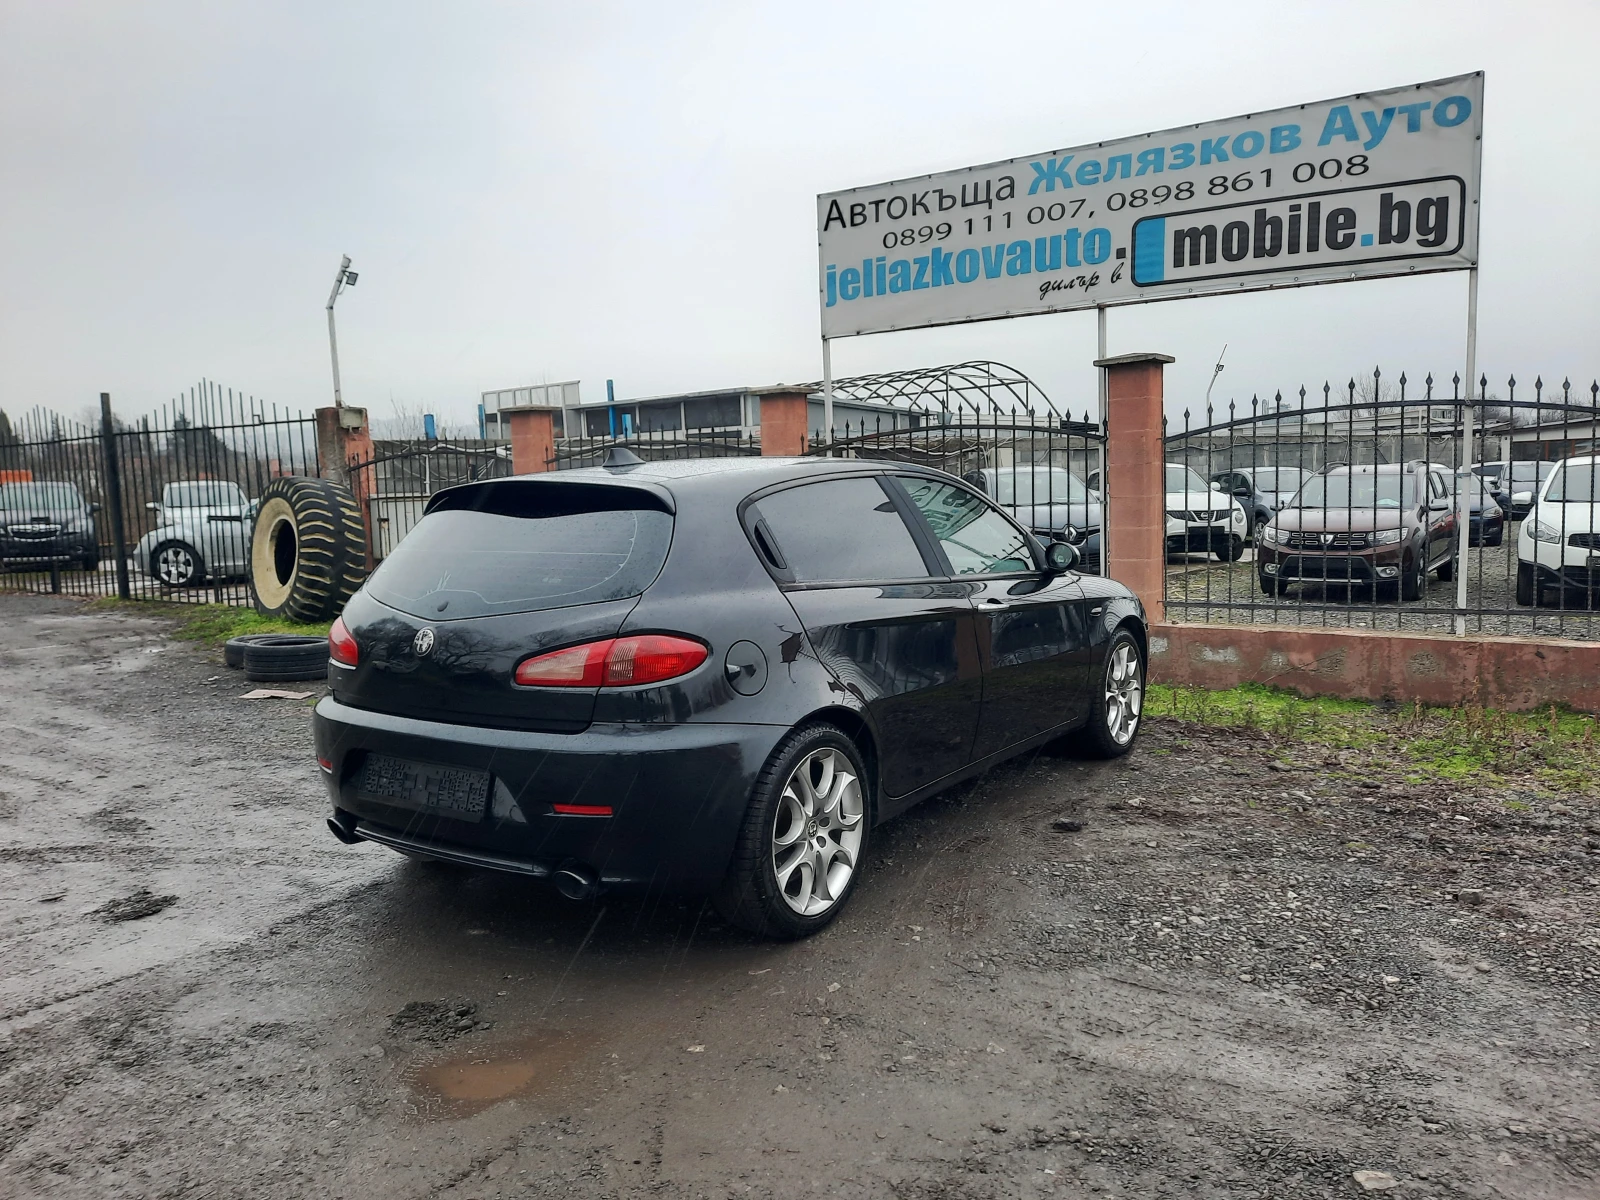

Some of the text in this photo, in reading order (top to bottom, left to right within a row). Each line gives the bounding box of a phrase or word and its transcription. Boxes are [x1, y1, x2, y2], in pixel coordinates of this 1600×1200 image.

[823, 95, 1472, 231] Автокъща Желязков Ауто
[882, 154, 1369, 249] 0899 111 007, 0898 861 008
